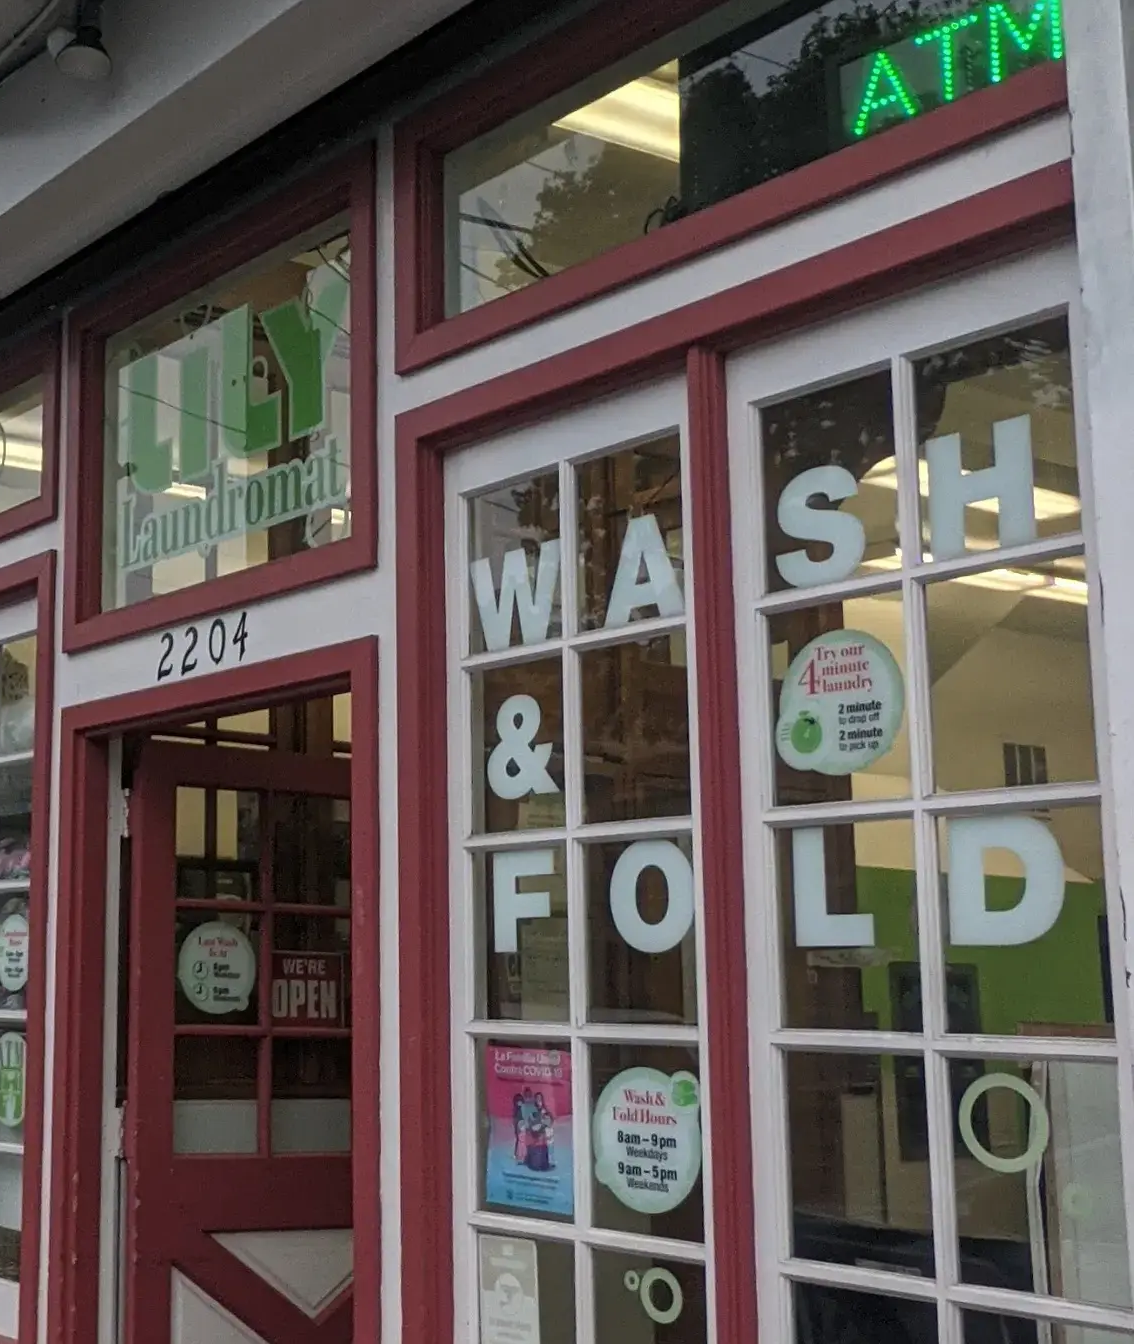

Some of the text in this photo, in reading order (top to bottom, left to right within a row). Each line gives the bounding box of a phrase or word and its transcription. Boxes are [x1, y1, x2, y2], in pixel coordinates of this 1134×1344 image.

[120, 263, 351, 495] LILY
[121, 438, 346, 568] Laundromat
[470, 413, 1037, 653] WASH
[157, 611, 249, 682] 2204
[815, 644, 865, 662] Try our
[798, 659, 820, 695] 4
[822, 660, 870, 676] minute
[823, 674, 873, 693] laundry
[838, 700, 882, 714] 2 minute
[839, 717, 846, 725] to
[869, 712, 880, 721] off
[839, 727, 883, 741] 2 minute
[487, 694, 561, 799] &
[492, 813, 1065, 954] FOLD
[282, 959, 326, 975] WE'RE
[271, 978, 337, 1019] OPEN
[623, 1089, 666, 1106] Wash &
[612, 1107, 677, 1126] Fold Hours
[626, 1146, 668, 1162] Weekdays
[626, 1178, 669, 1193] Weekends
